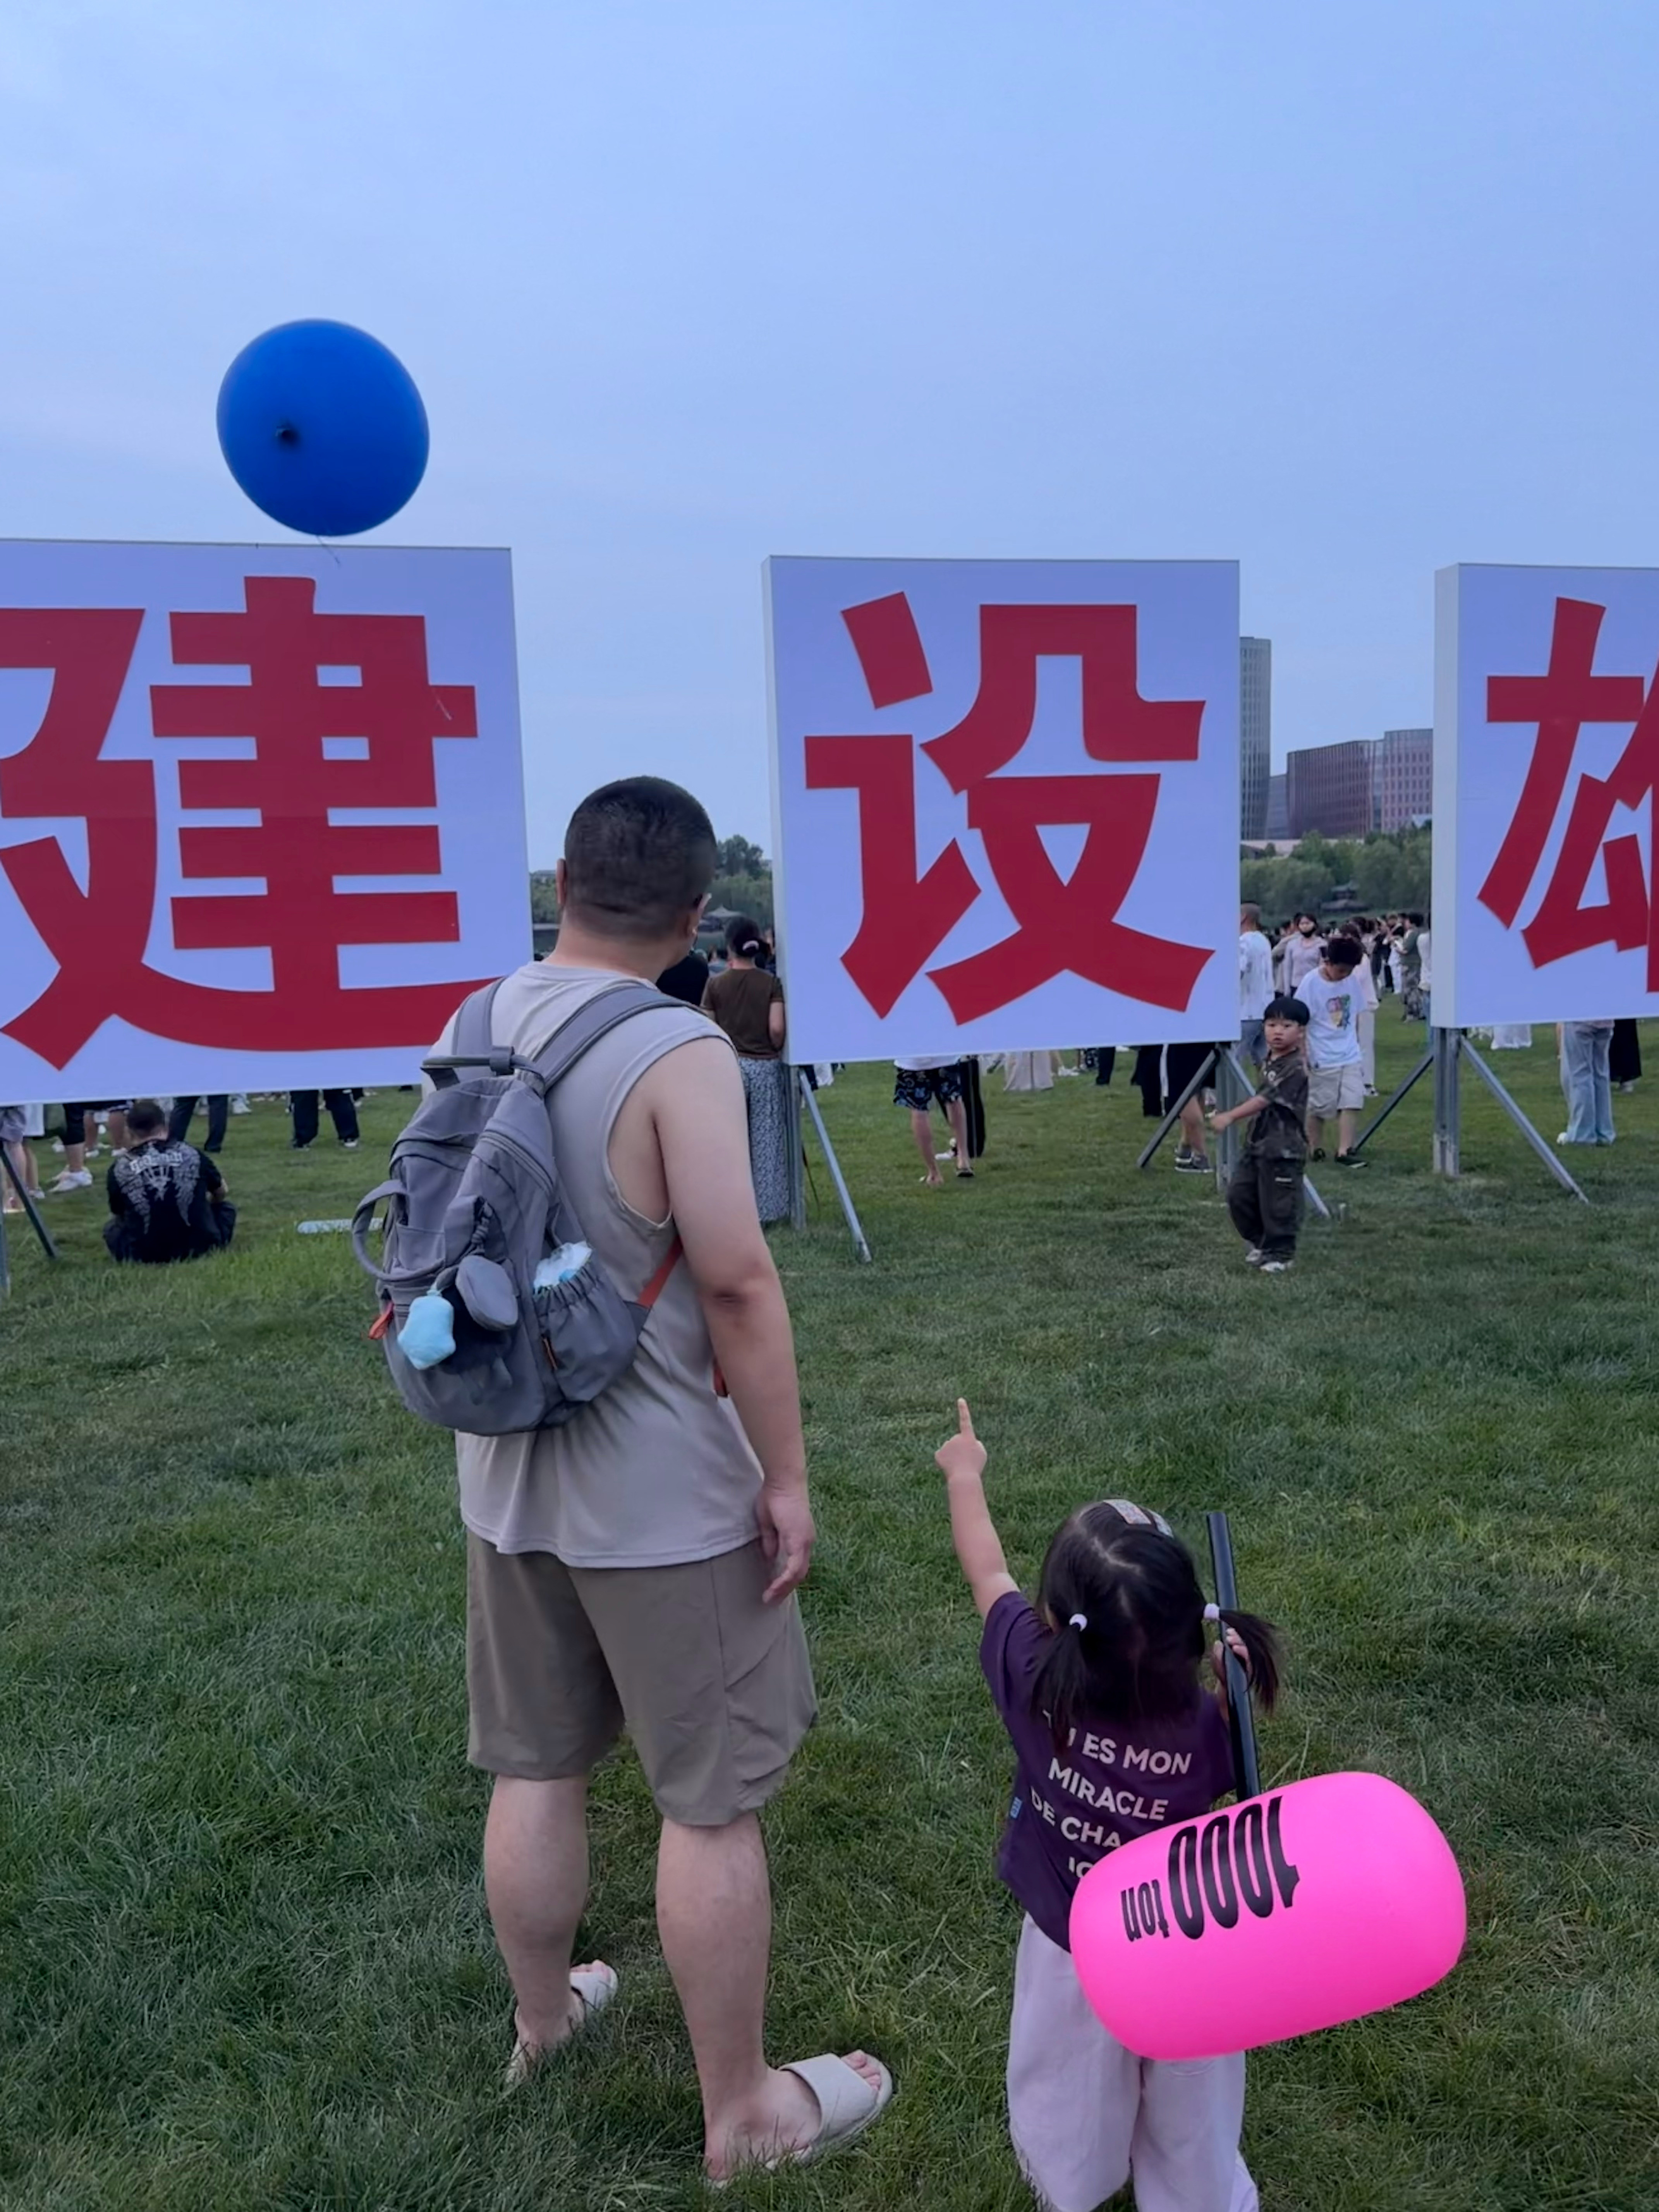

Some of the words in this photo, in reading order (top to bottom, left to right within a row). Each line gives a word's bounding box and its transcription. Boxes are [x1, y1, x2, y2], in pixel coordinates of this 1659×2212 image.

[804, 591, 1216, 1025] 设
[1082, 1732, 1117, 1764] ES
[1123, 1745, 1192, 1775] MON
[1031, 1786, 1056, 1826] DE
[1061, 1817, 1121, 1847] CHA
[1048, 1758, 1168, 1820] MIRACLE
